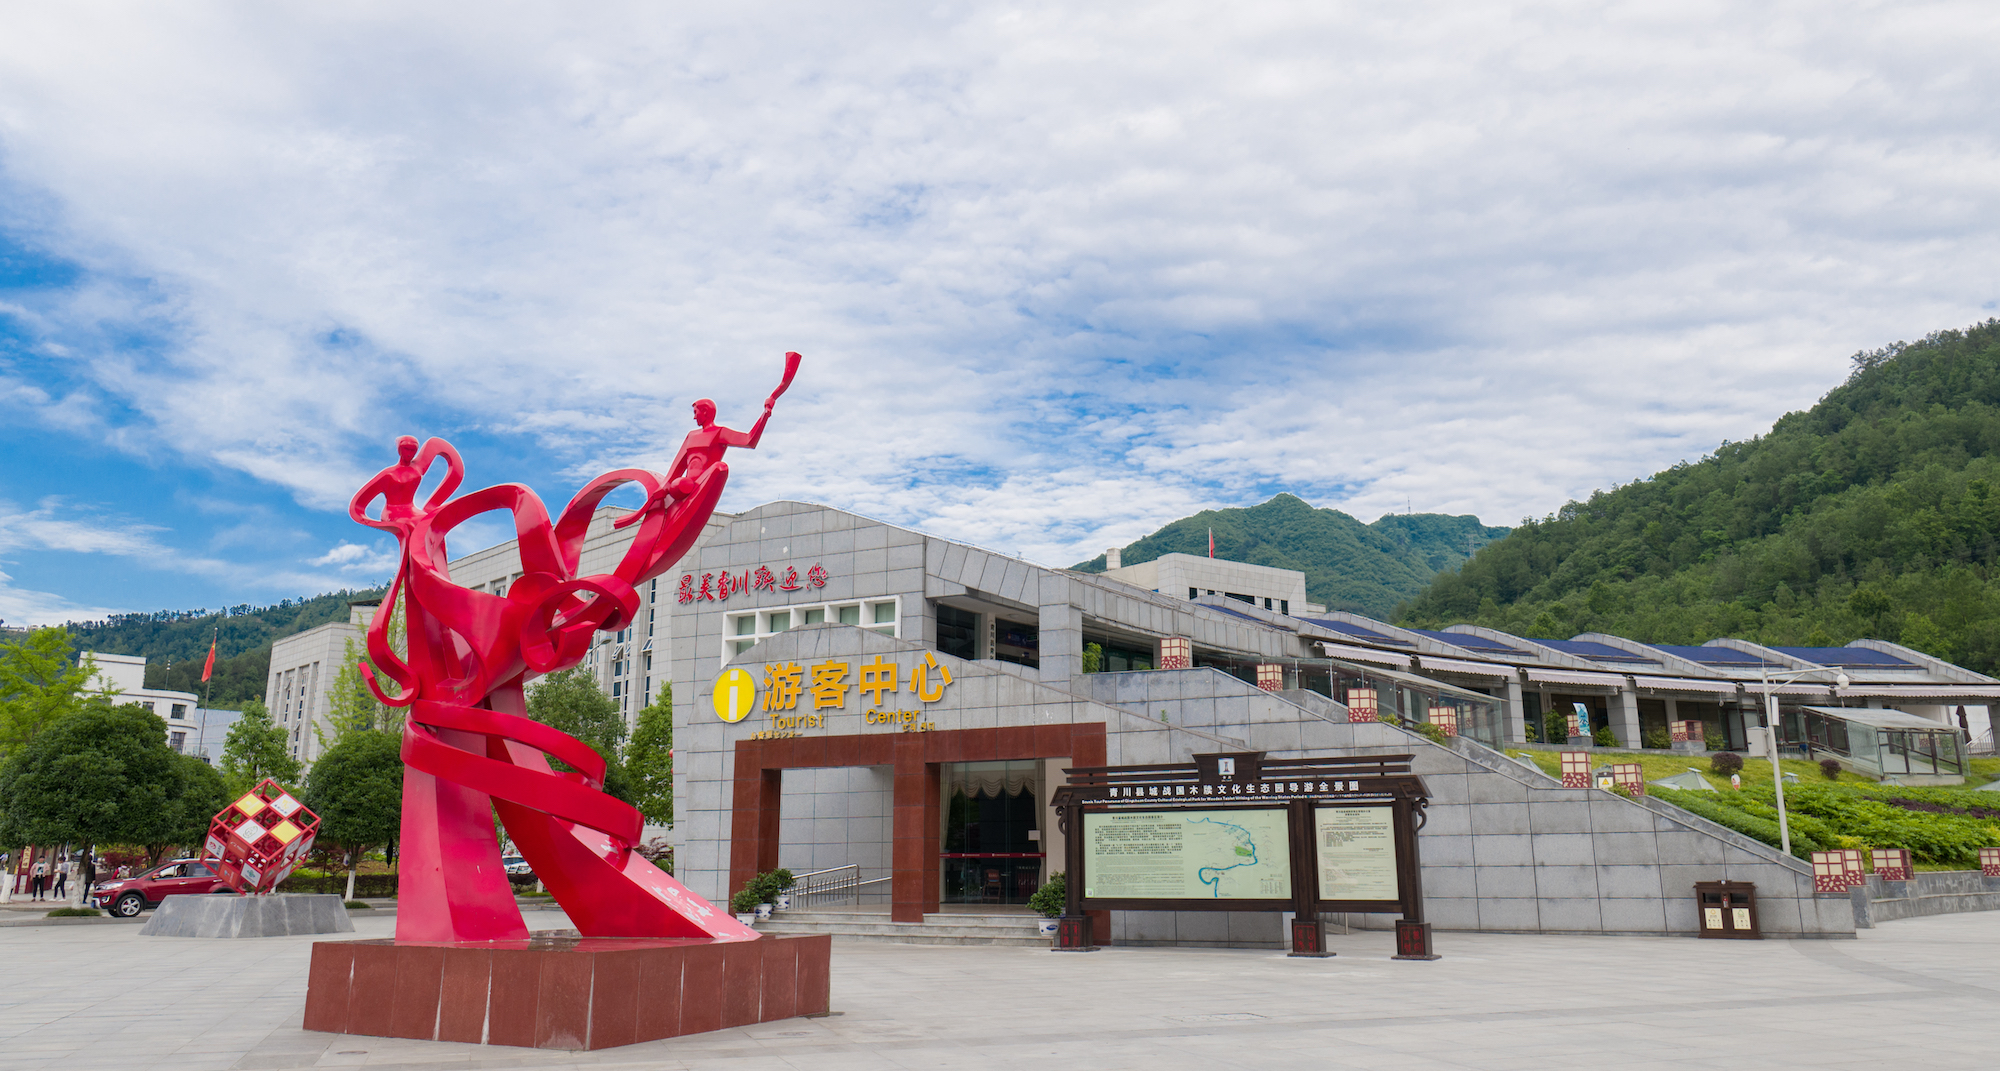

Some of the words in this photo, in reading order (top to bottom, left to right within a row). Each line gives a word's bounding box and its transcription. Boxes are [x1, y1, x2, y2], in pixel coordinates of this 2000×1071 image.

[762, 651, 953, 711] 游客中心
[770, 714, 825, 729] Tourist
[866, 708, 920, 724] Center
